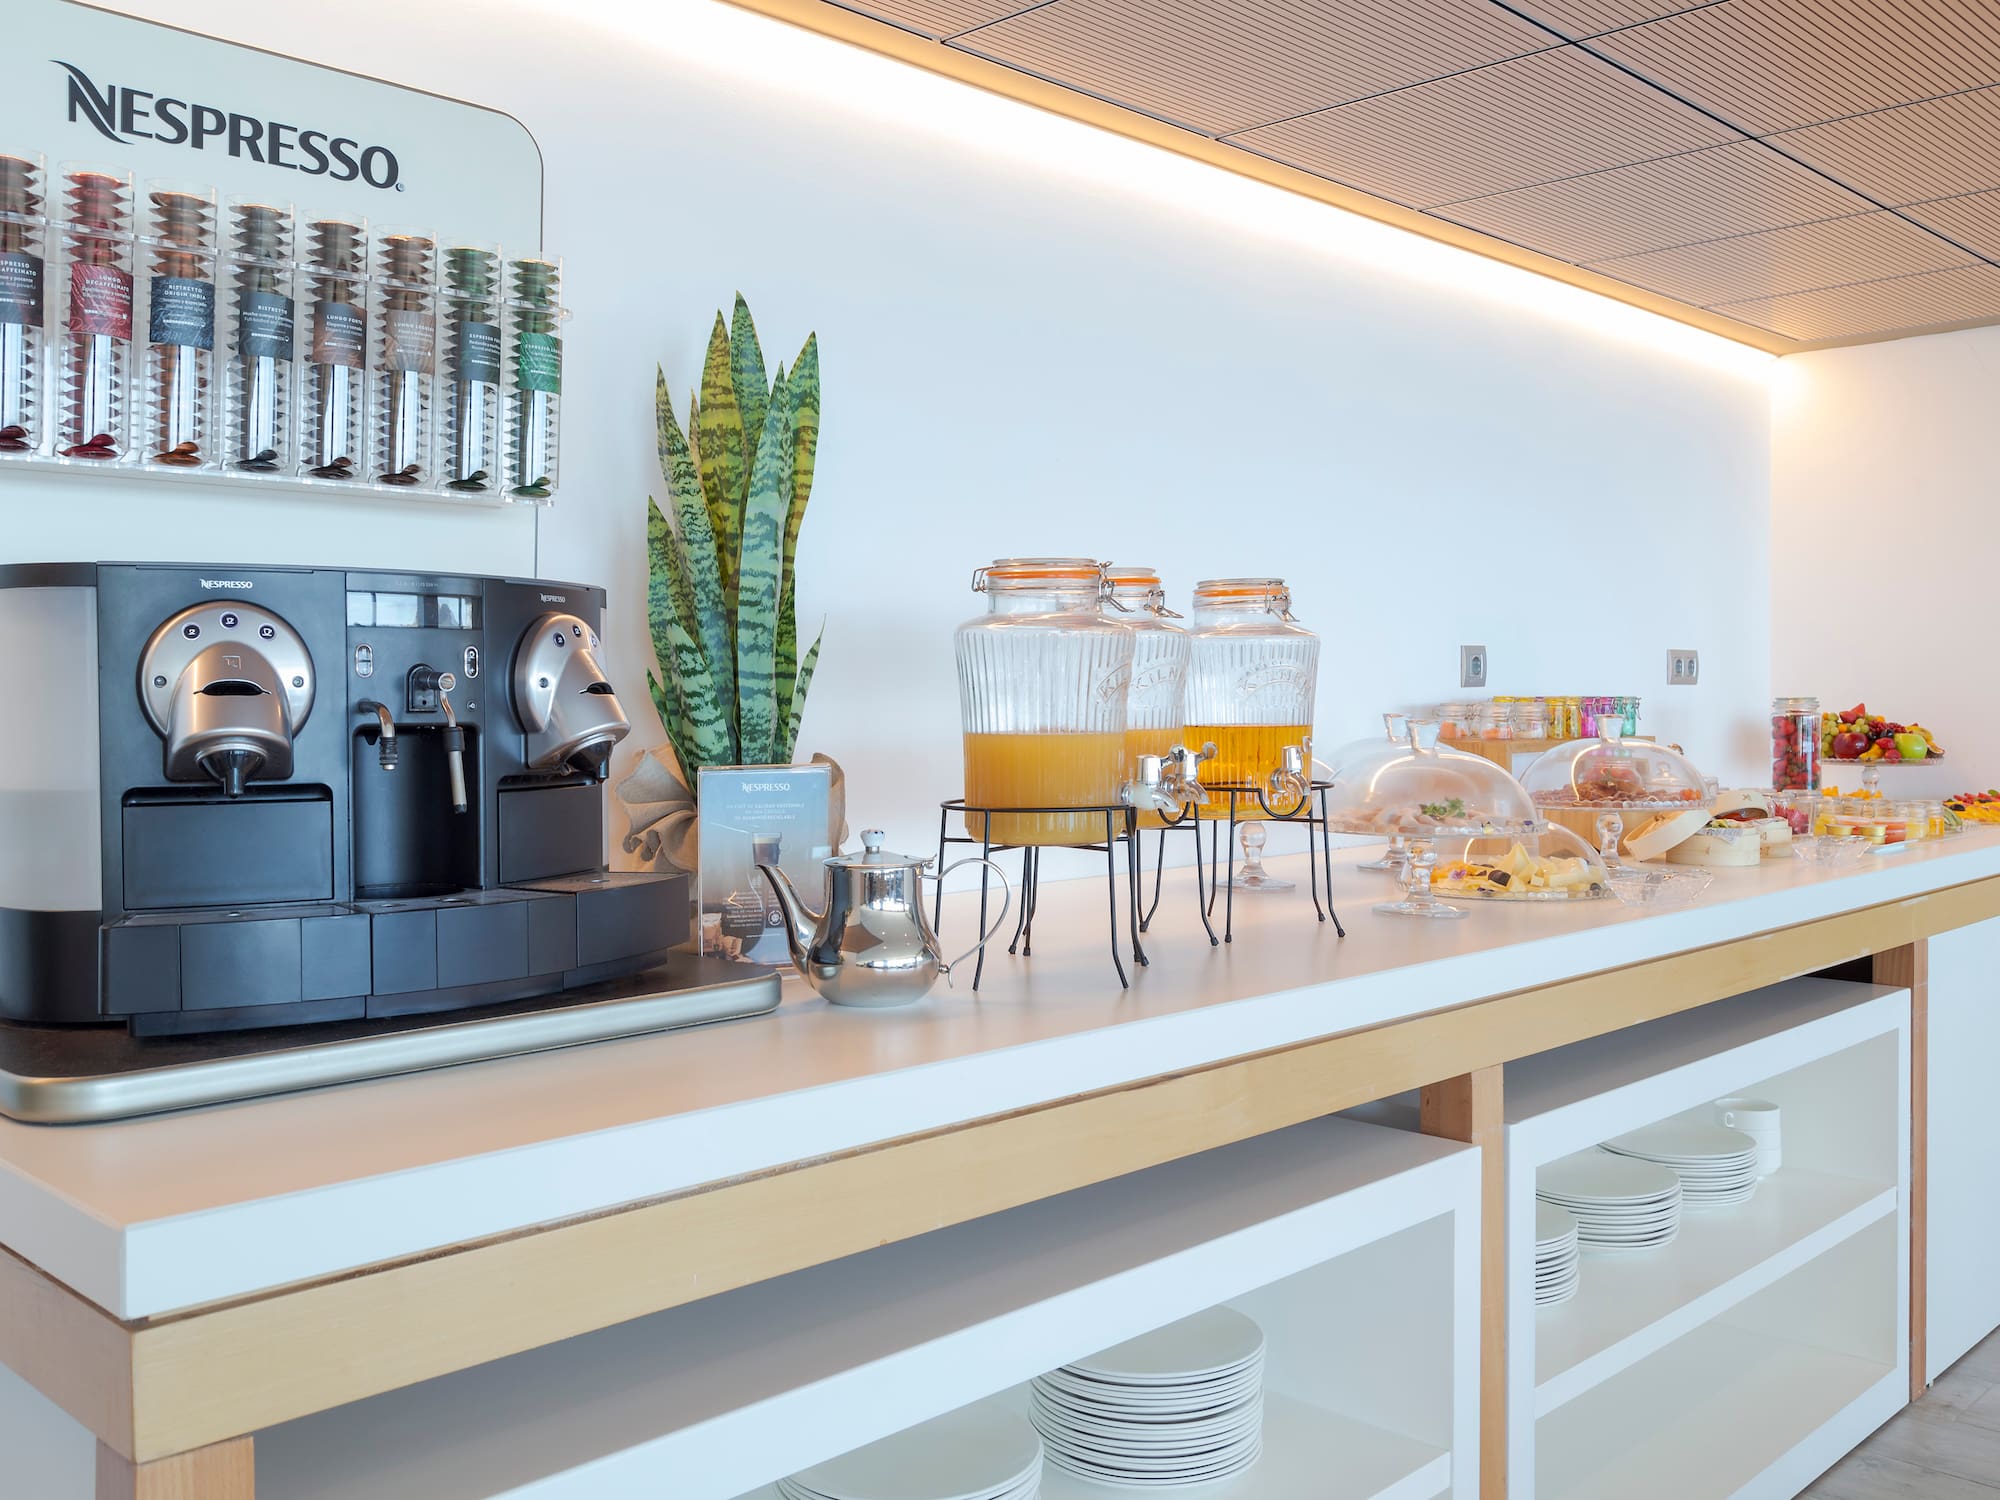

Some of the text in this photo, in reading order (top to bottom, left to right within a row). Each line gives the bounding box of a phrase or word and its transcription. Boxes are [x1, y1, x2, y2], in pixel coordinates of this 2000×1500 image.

[48, 60, 399, 189] NESPRESSO
[0, 260, 30, 269] SPRESSO
[1, 267, 37, 277] AFFEINATO
[99, 274, 121, 284] LUNGO
[85, 279, 130, 292] DECAFFEINATO
[168, 284, 203, 294] RISTRETTO
[164, 290, 188, 298] ORIGIN
[189, 292, 207, 301] INDIA
[257, 304, 288, 316] RISTRETTO
[326, 314, 348, 322] LUNGO
[469, 333, 494, 342] ESPRESSO
[200, 578, 253, 590] NESPRESSO
[540, 592, 566, 604] NESPRESSO
[741, 781, 792, 793] NESPRESSO
